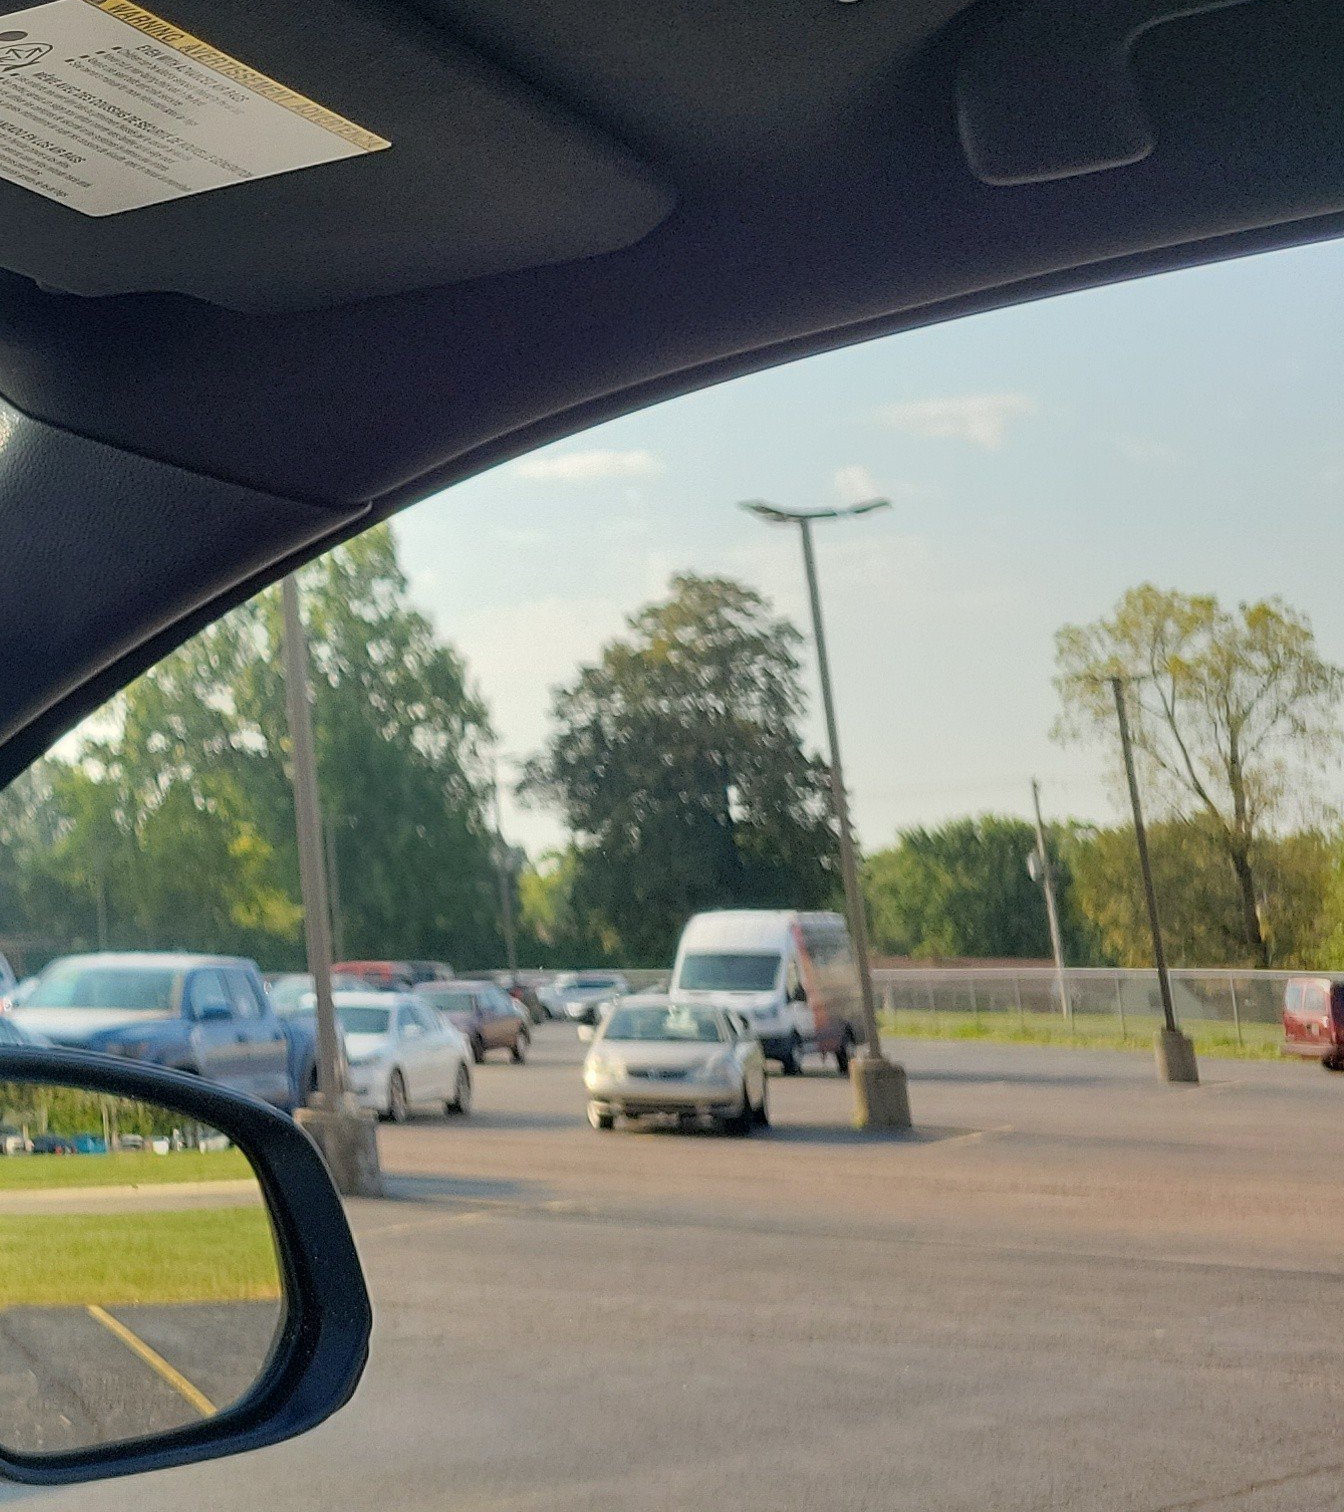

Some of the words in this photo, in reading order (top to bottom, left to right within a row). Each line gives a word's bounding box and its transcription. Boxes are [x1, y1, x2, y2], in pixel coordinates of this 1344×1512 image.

[108, 4, 184, 42] WARNING
[179, 43, 296, 102] AVERTISSEMENT
[135, 45, 163, 57] EVEN
[54, 82, 81, 93] AVEC
[73, 91, 96, 101] DES
[20, 133, 40, 141] EN
[32, 139, 55, 148] LOS
